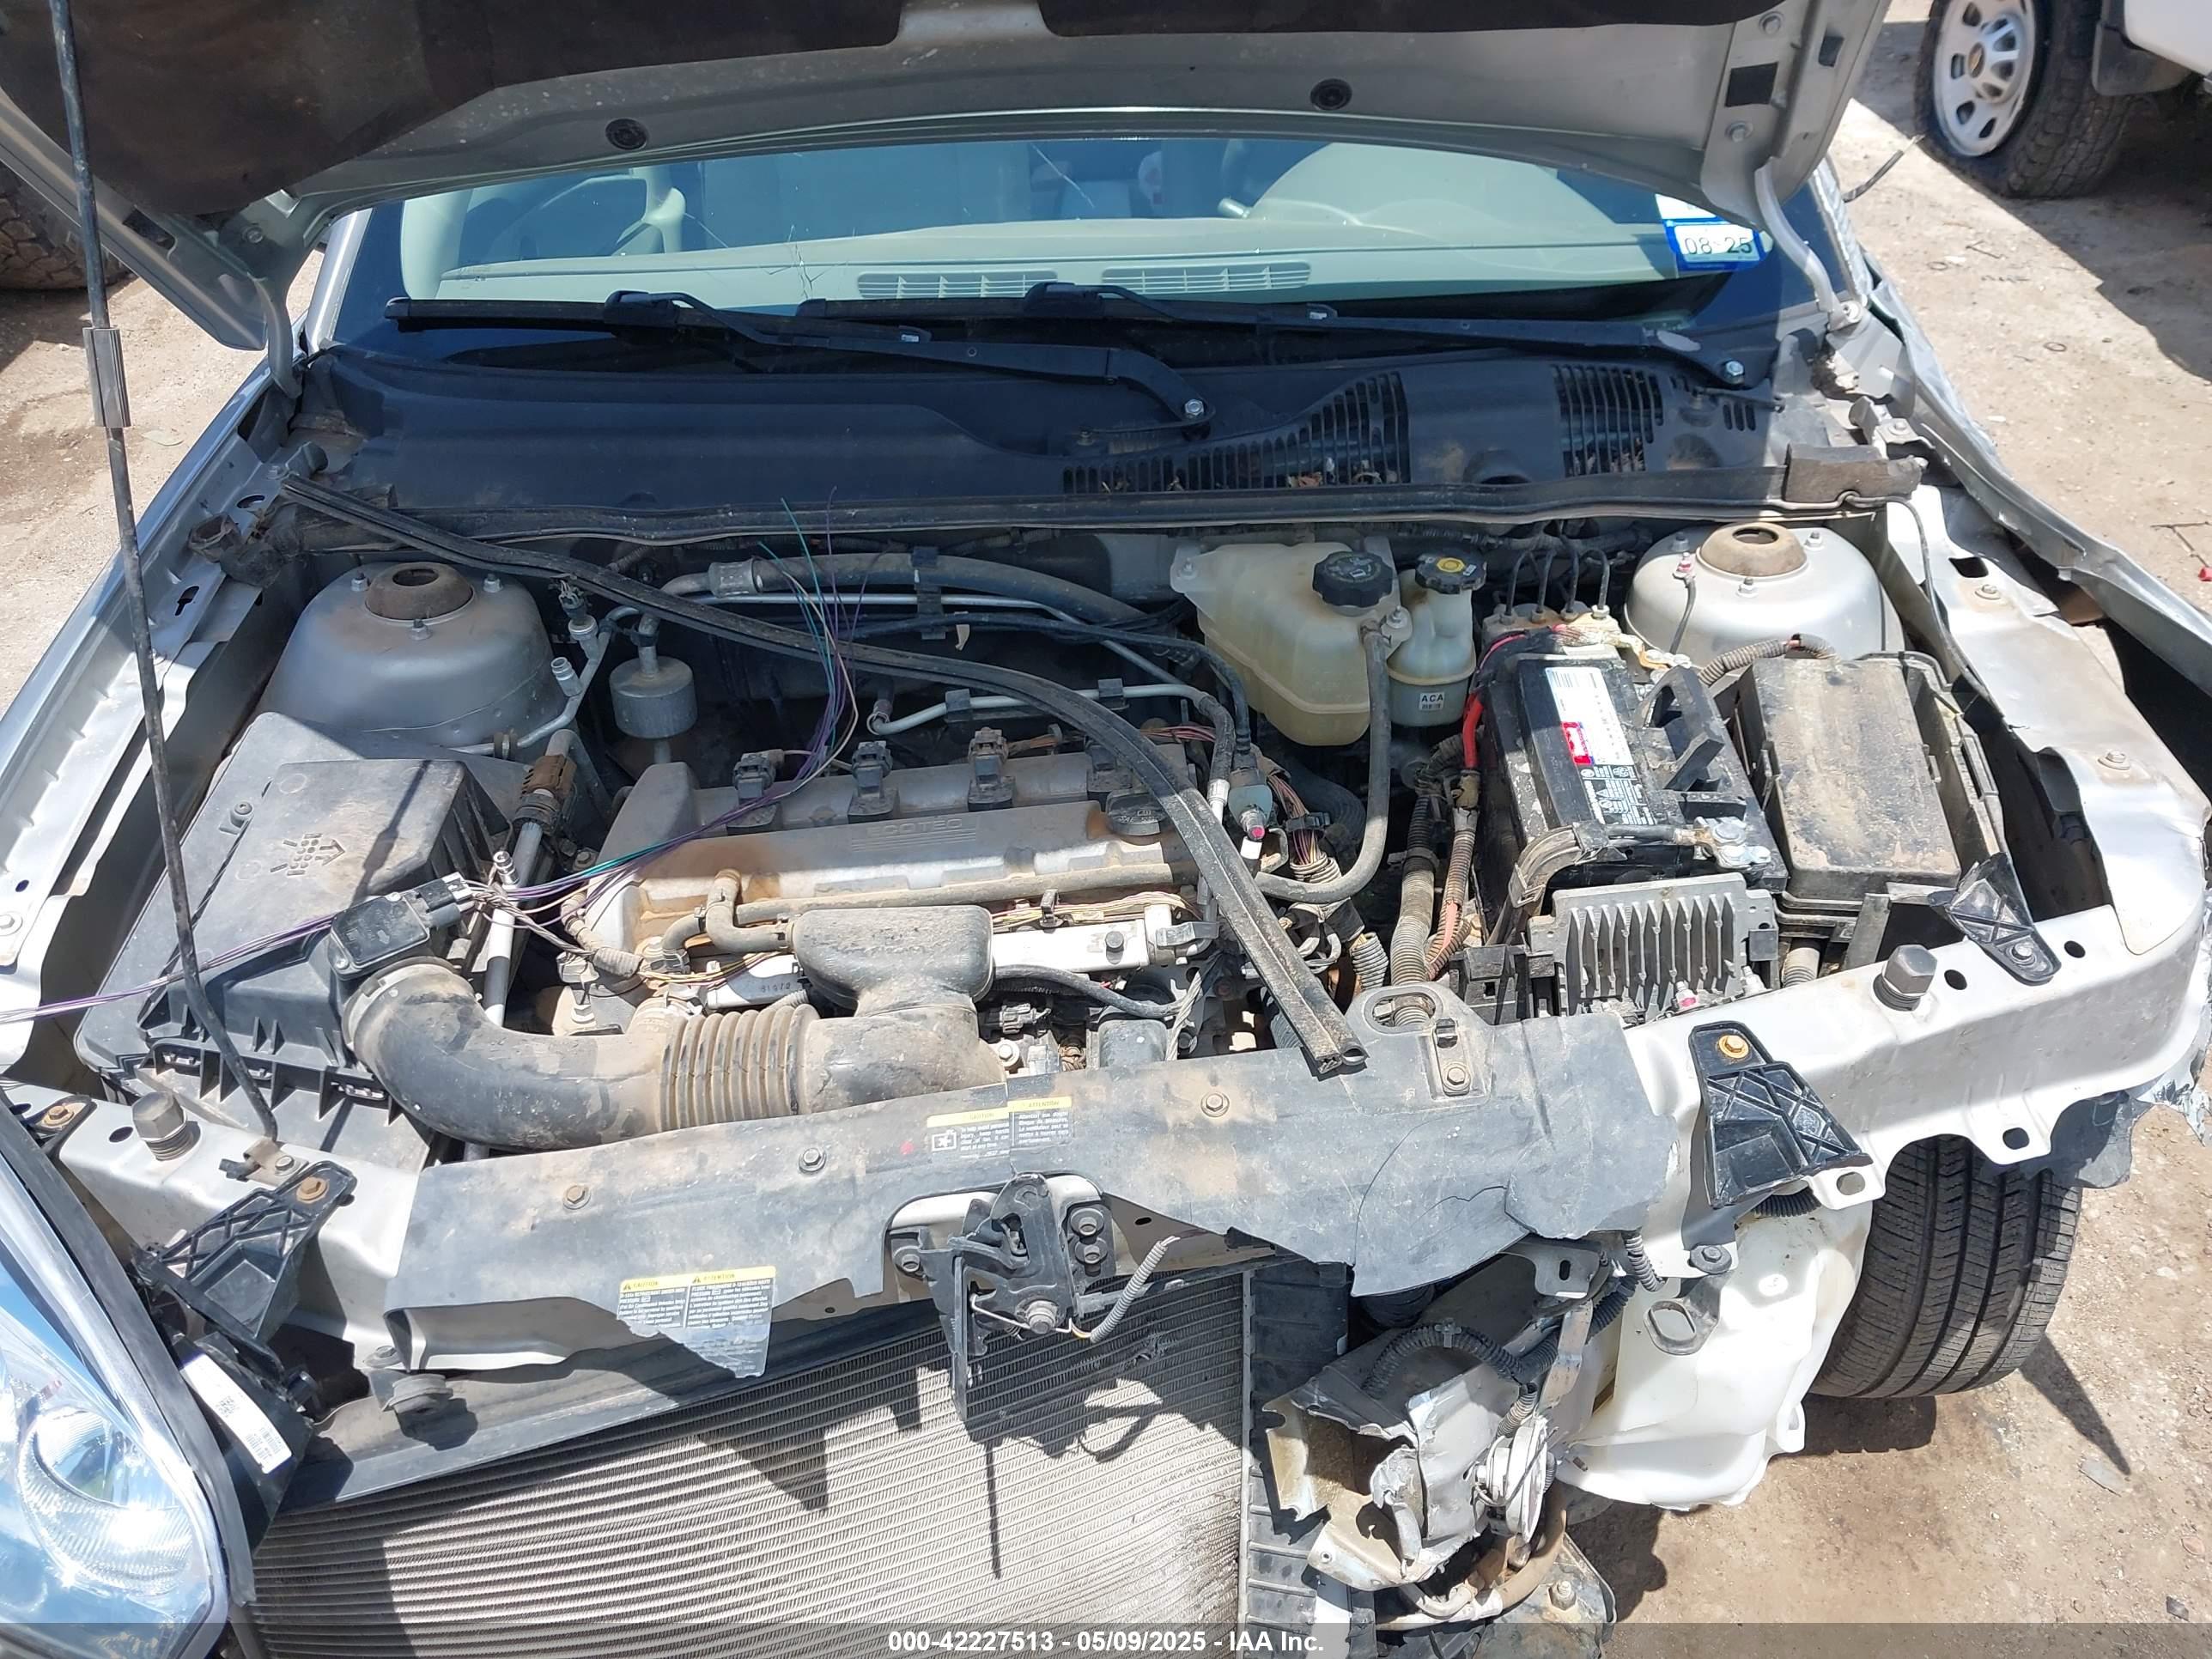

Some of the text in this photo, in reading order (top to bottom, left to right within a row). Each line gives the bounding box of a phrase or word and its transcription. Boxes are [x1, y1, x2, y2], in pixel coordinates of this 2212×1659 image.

[1684, 236, 1752, 254] 08 25
[1421, 694, 1443, 702] ACA
